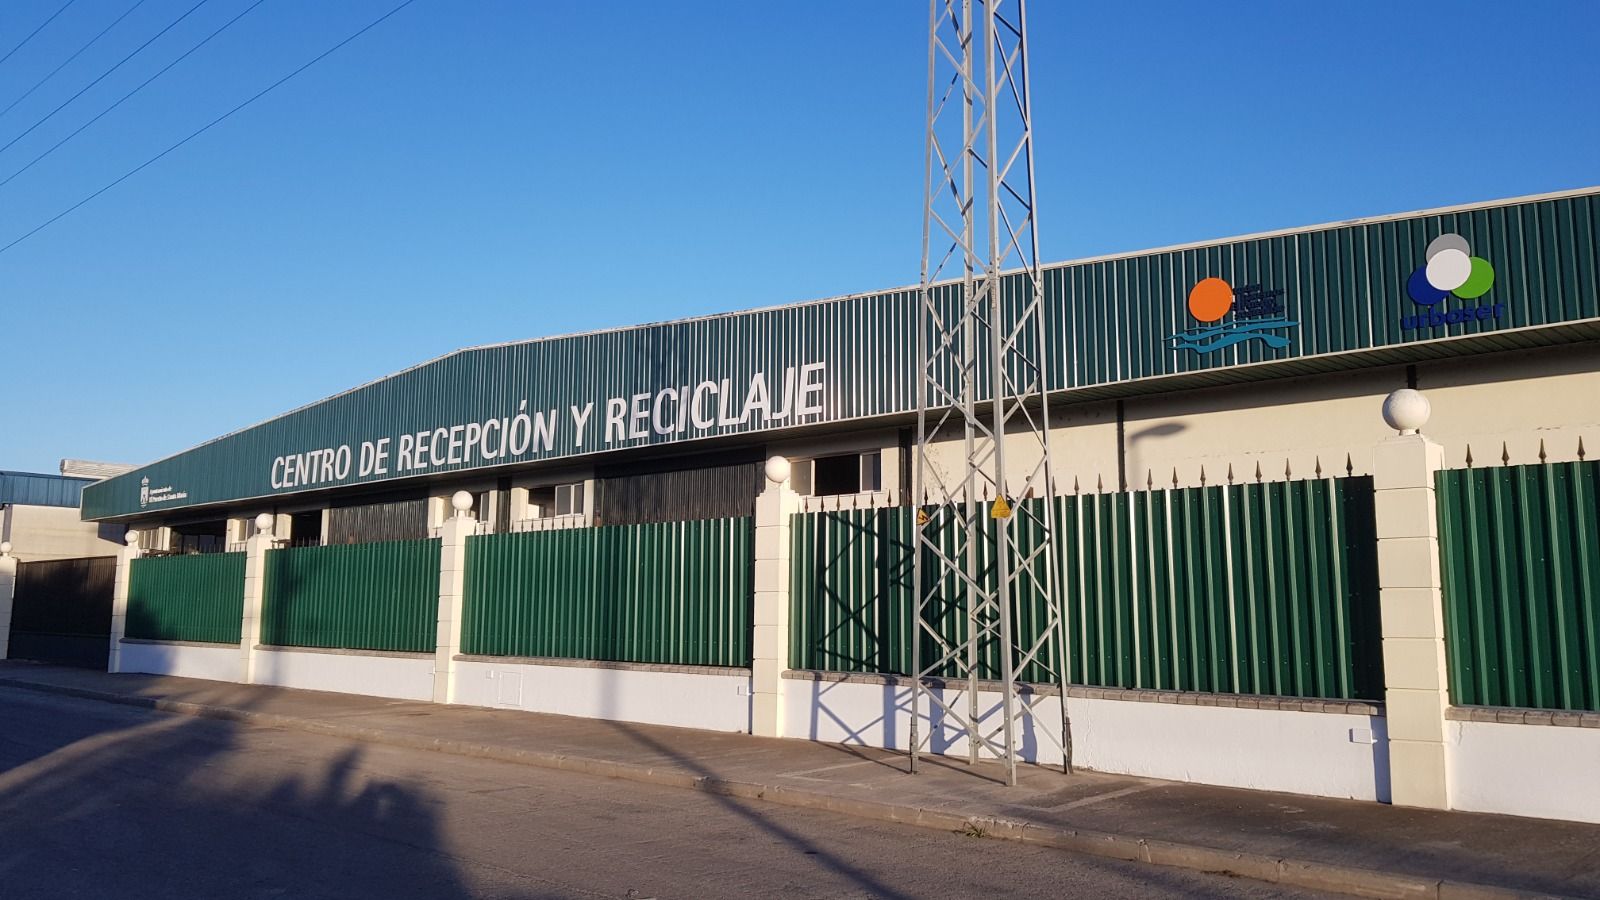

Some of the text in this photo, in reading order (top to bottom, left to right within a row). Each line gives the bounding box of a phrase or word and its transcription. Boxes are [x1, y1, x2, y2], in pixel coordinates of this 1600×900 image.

[1402, 303, 1504, 330] urbaser
[271, 361, 825, 489] CENTRO DE RECEPCIÓN Y RECICLAJE
